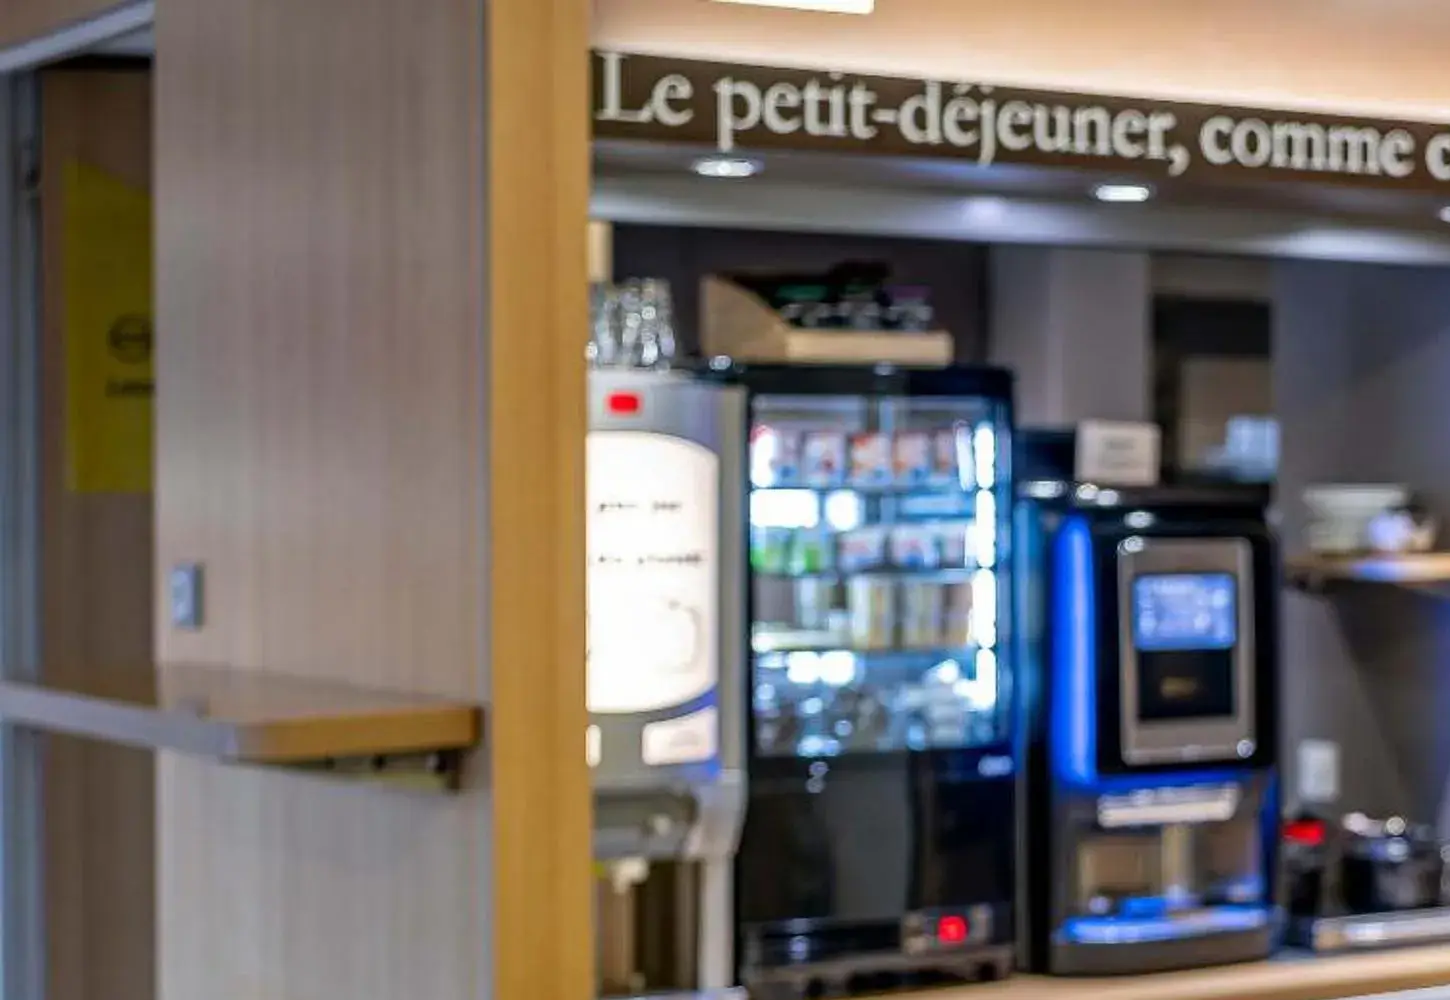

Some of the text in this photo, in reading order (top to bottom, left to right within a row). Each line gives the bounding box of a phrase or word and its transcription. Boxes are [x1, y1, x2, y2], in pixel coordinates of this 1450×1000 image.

[594, 51, 696, 128] Le
[712, 72, 1191, 177] petit-déjeuner,
[1199, 114, 1416, 178] comme
